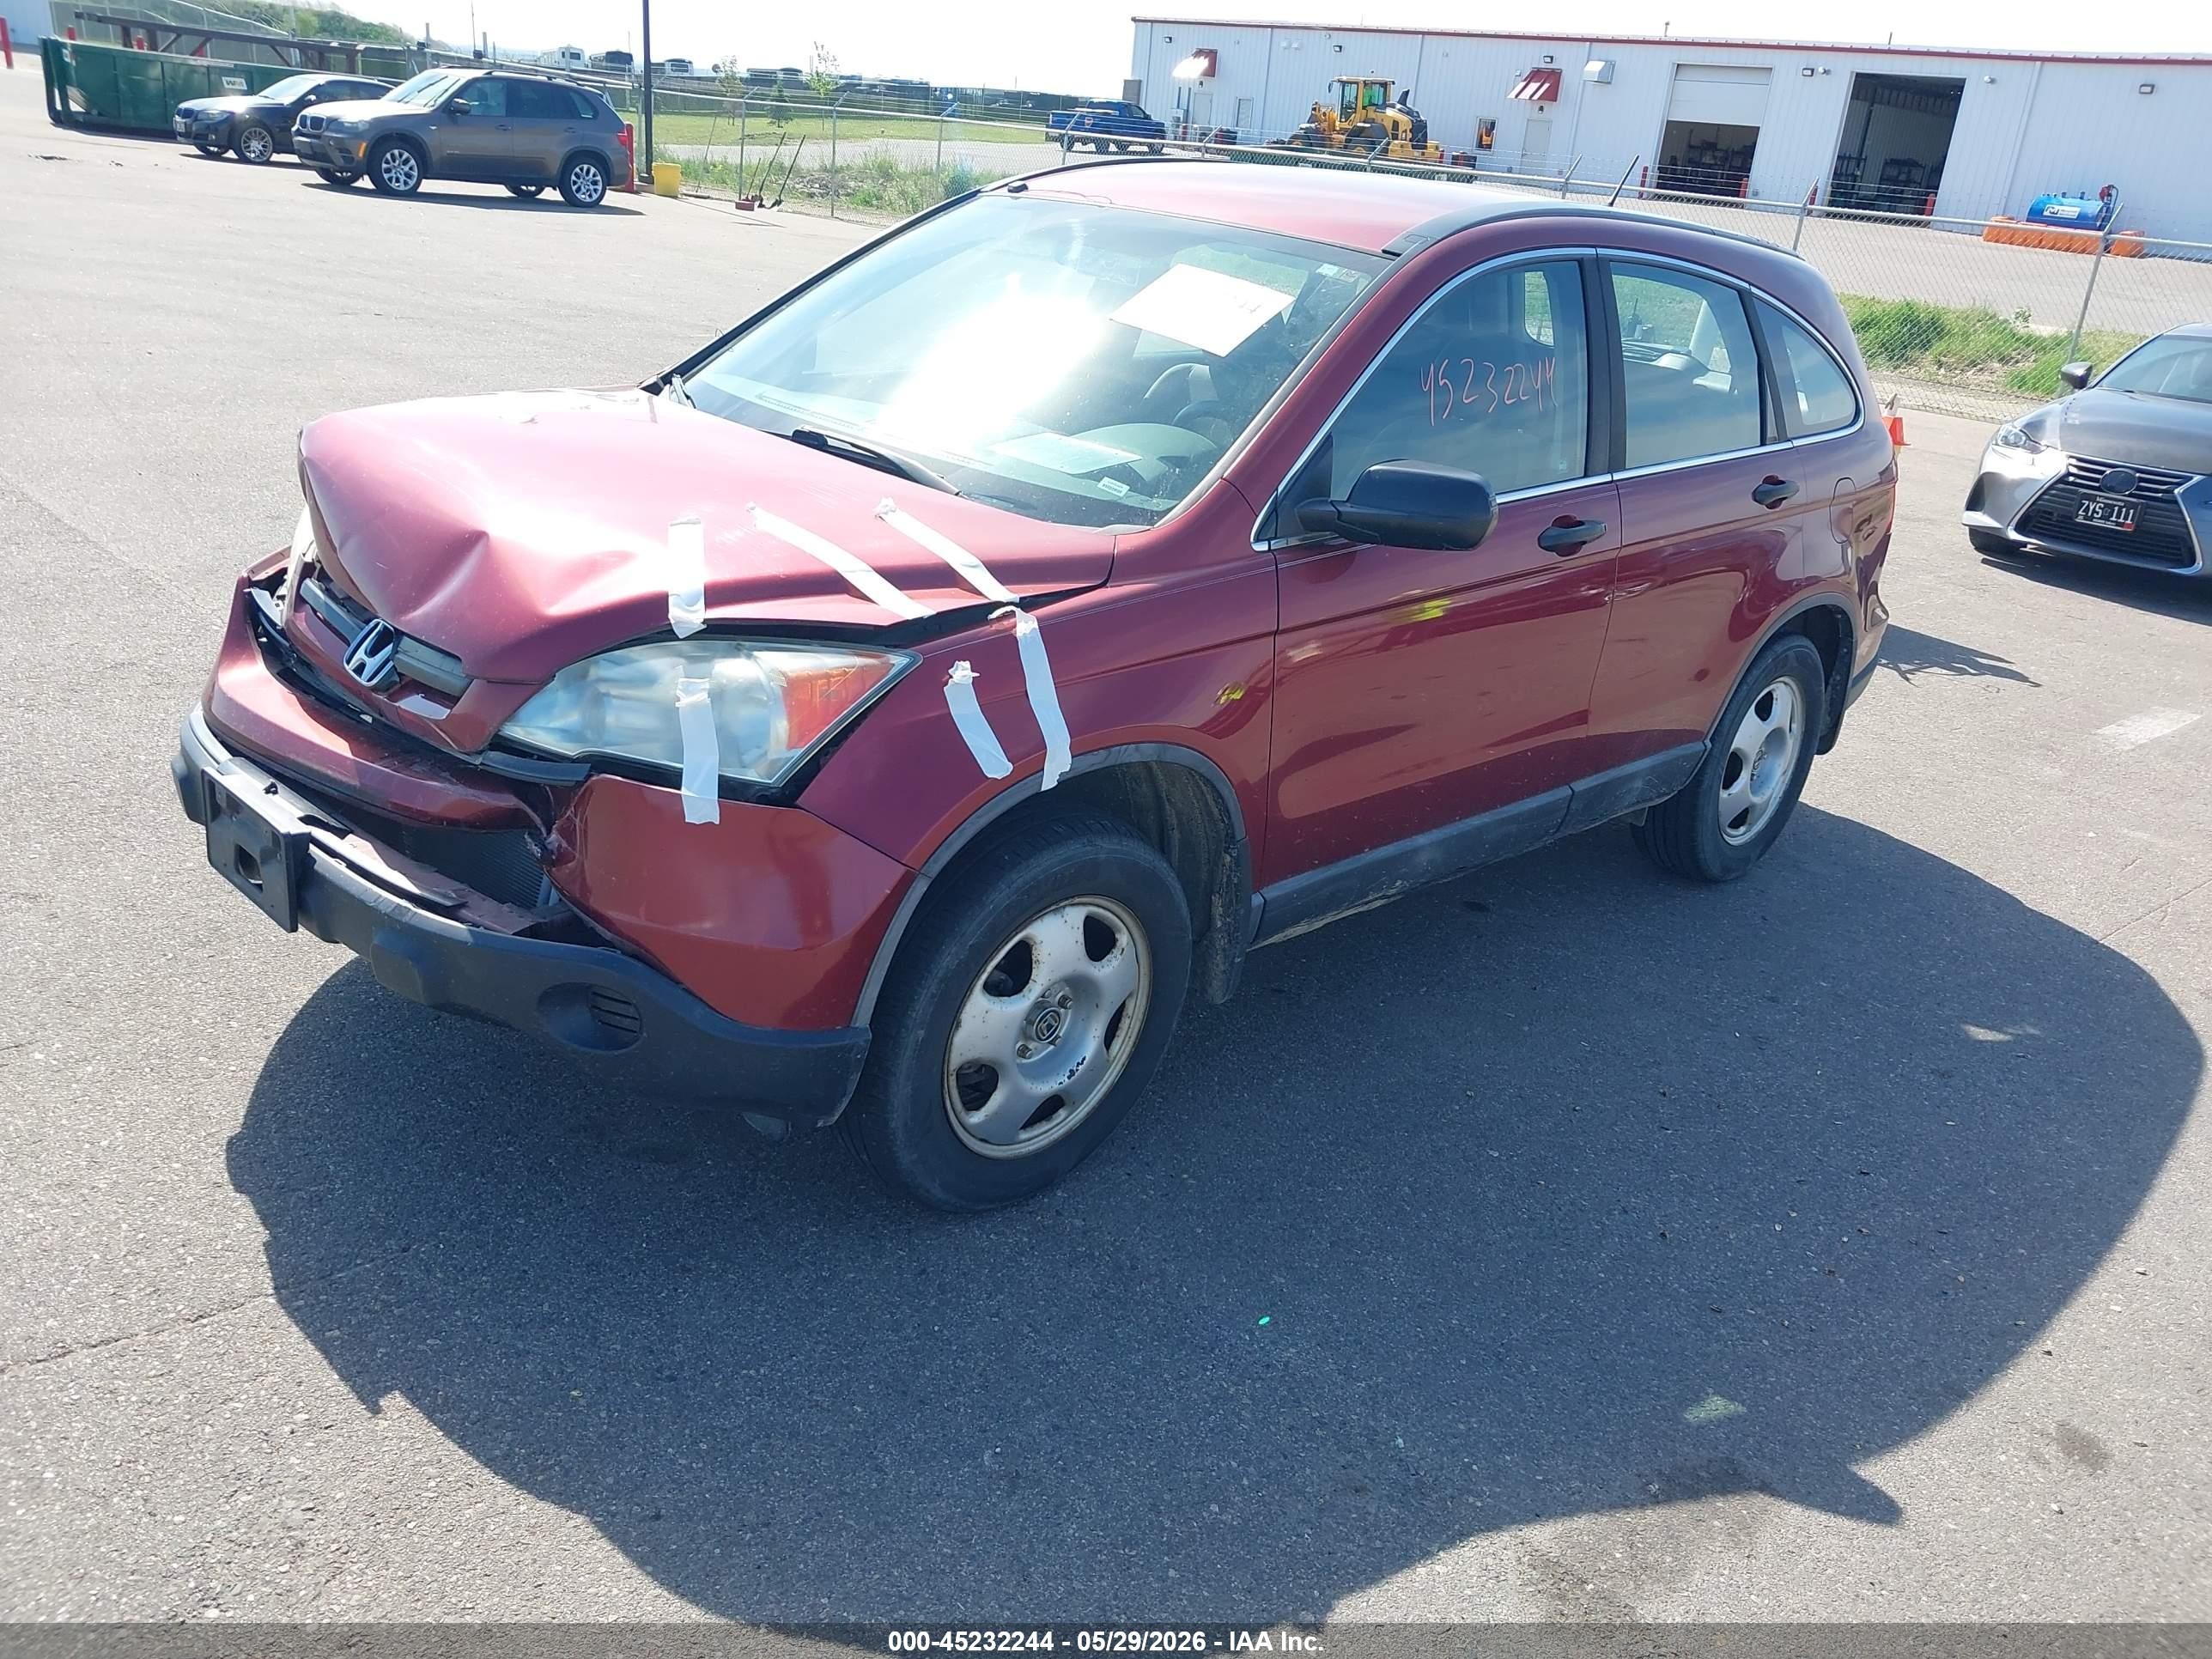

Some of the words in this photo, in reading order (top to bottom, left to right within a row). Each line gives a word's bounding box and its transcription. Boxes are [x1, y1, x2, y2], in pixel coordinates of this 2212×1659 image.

[1420, 356, 1559, 427] 45232244
[2078, 500, 2104, 518] ZYS
[2109, 506, 2135, 523] 111
